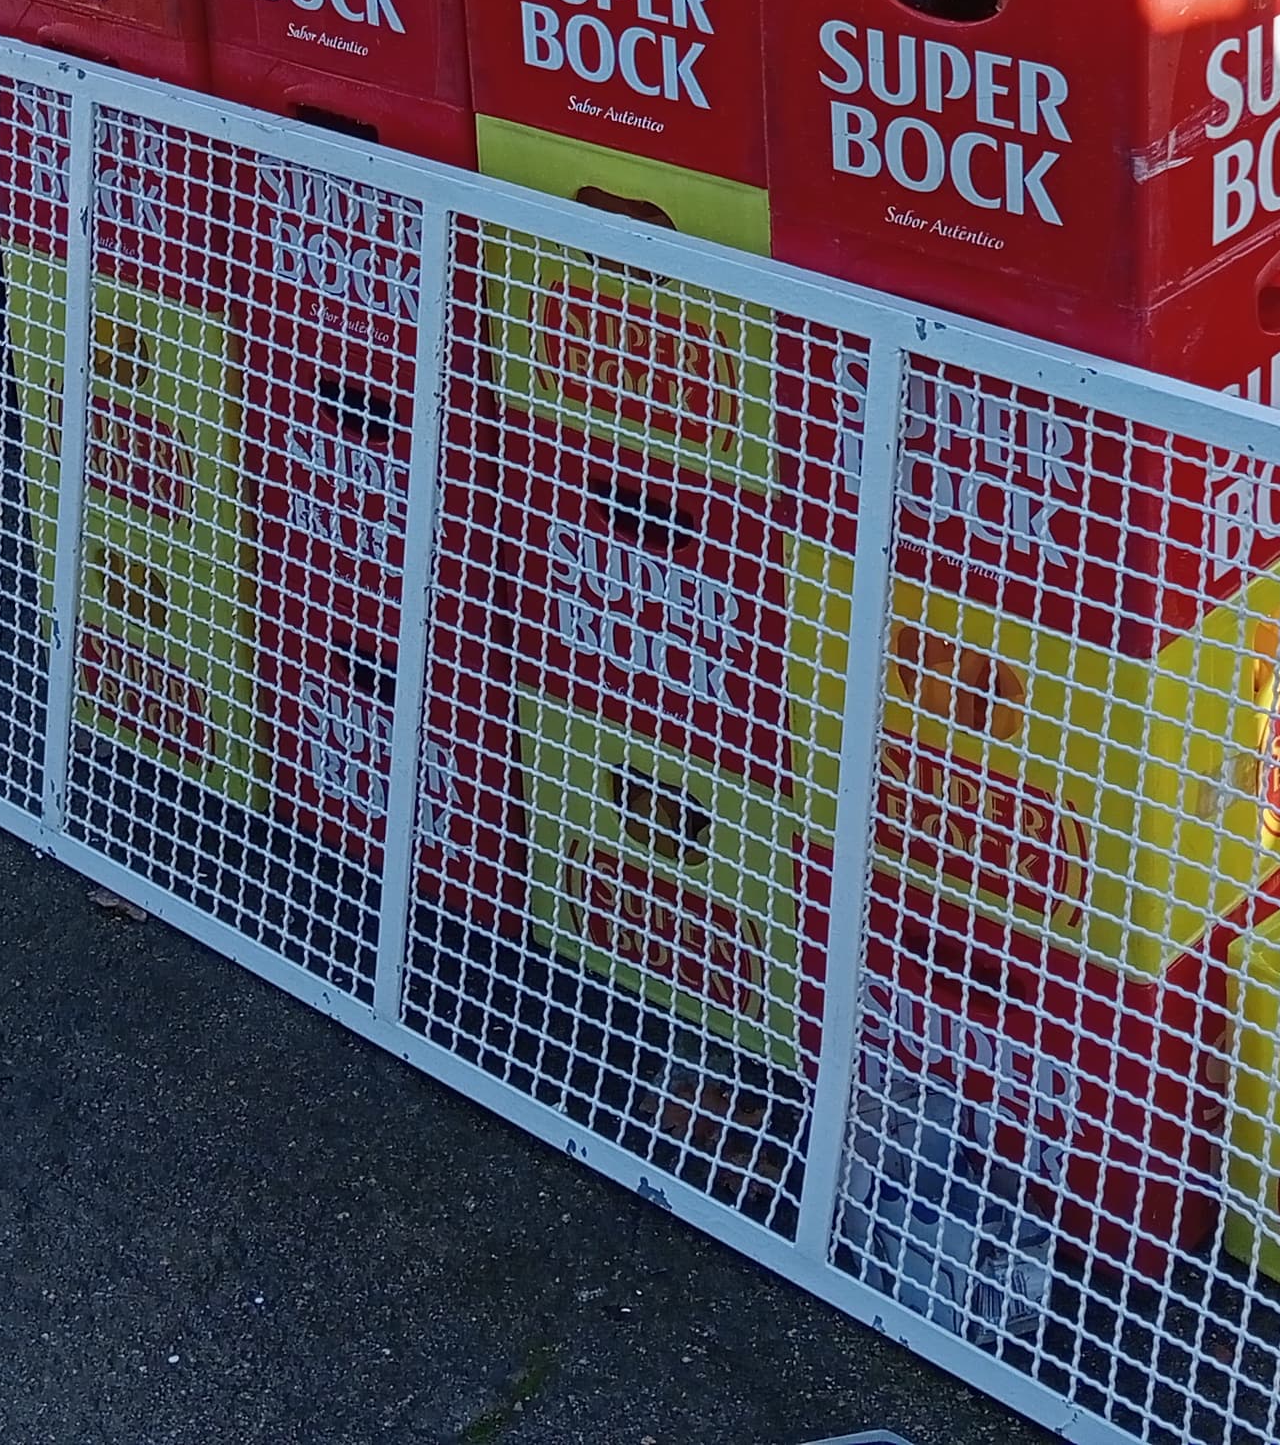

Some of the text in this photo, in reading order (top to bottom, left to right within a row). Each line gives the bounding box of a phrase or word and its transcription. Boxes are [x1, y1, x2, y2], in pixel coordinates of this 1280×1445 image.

[287, 22, 368, 57] Sabor Autêntico
[520, 1, 710, 110] BOCK
[819, 19, 1072, 143] SUPER
[568, 94, 664, 134] Sabor Autêntico
[830, 100, 1063, 227] BOCK
[884, 205, 1005, 251] Sabor Autêntico
[547, 522, 744, 652] SUPER
[557, 588, 739, 718] BOCK
[302, 681, 463, 805] SUPR
[311, 741, 461, 863] BOK
[862, 980, 1084, 1137] SUPER
